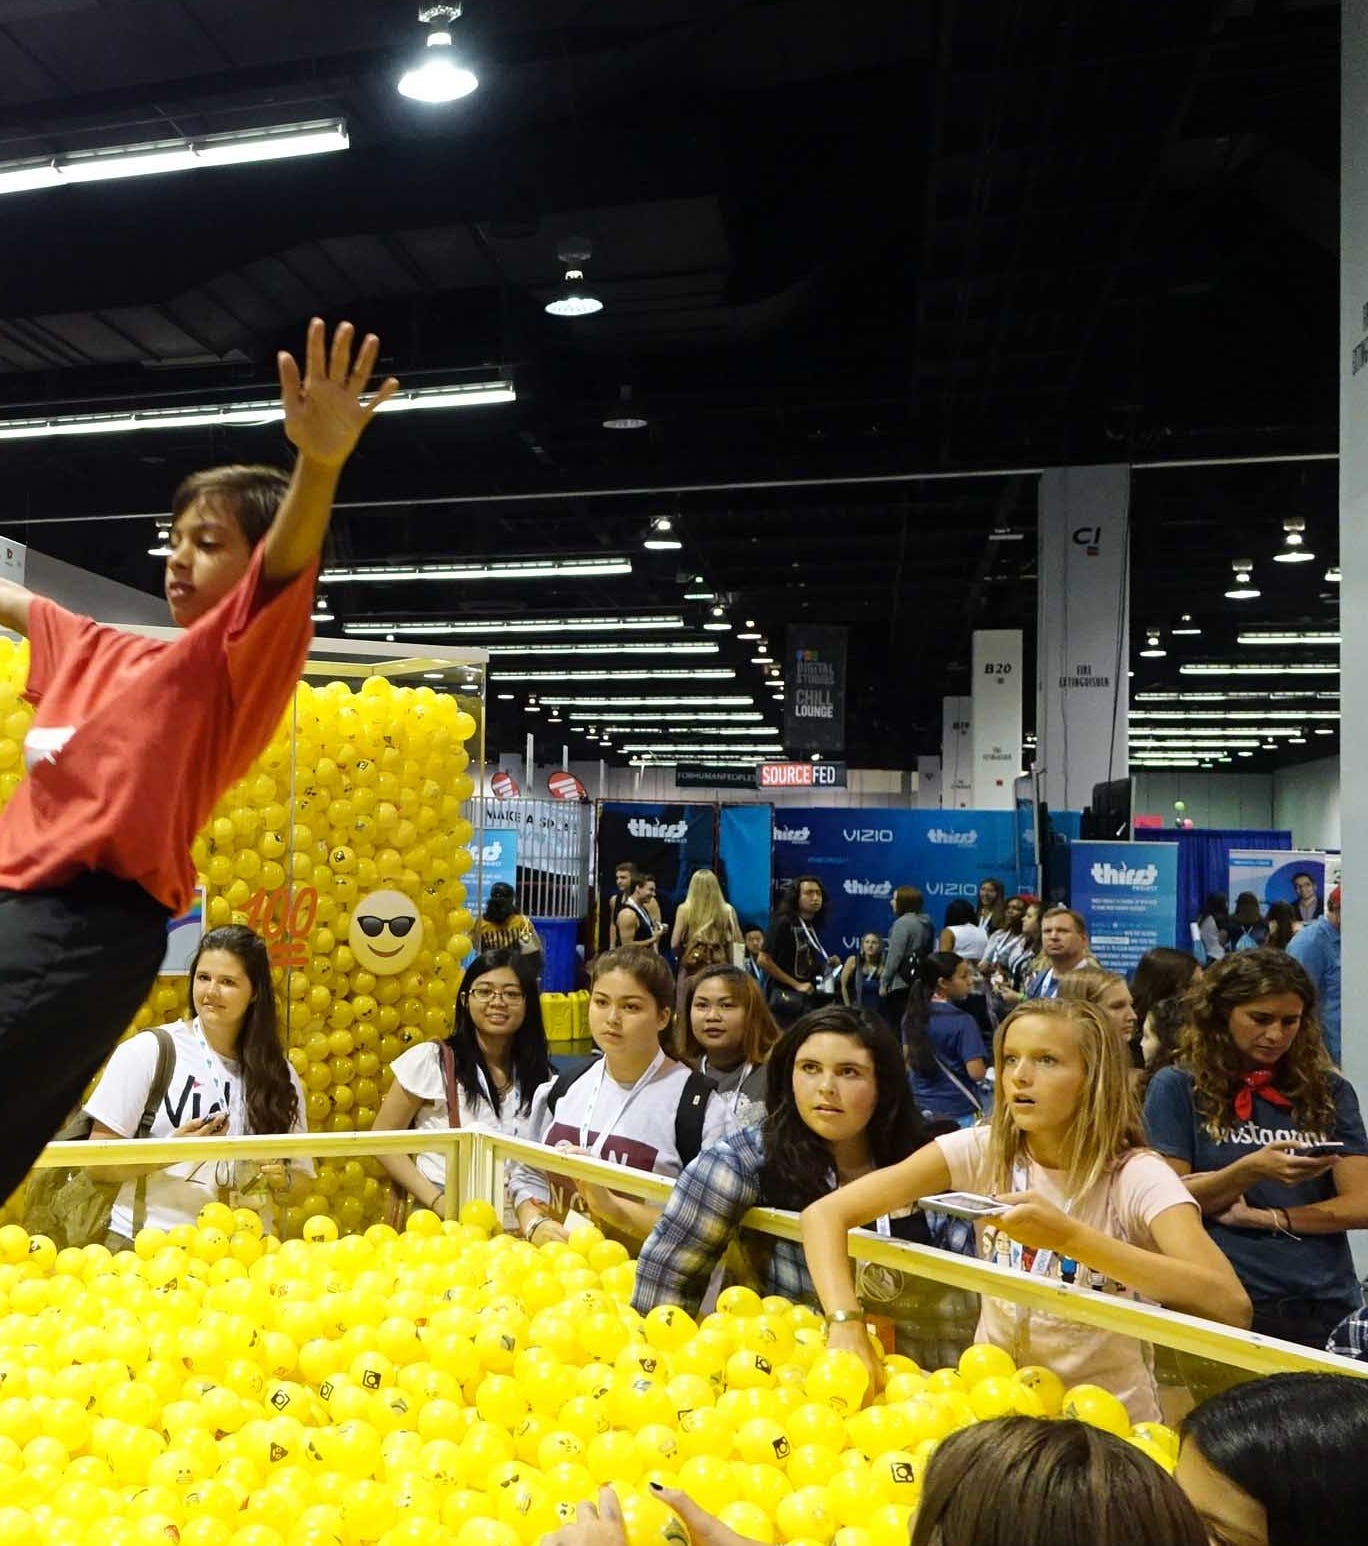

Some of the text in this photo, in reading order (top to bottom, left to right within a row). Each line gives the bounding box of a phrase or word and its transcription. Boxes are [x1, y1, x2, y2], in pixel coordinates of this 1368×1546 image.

[984, 663, 1012, 674] B20
[795, 689, 833, 706] CHILL
[795, 704, 834, 718] LOUNGE
[773, 824, 810, 841] hirst
[843, 829, 893, 842] VIZIO
[926, 882, 978, 896] VIZIO
